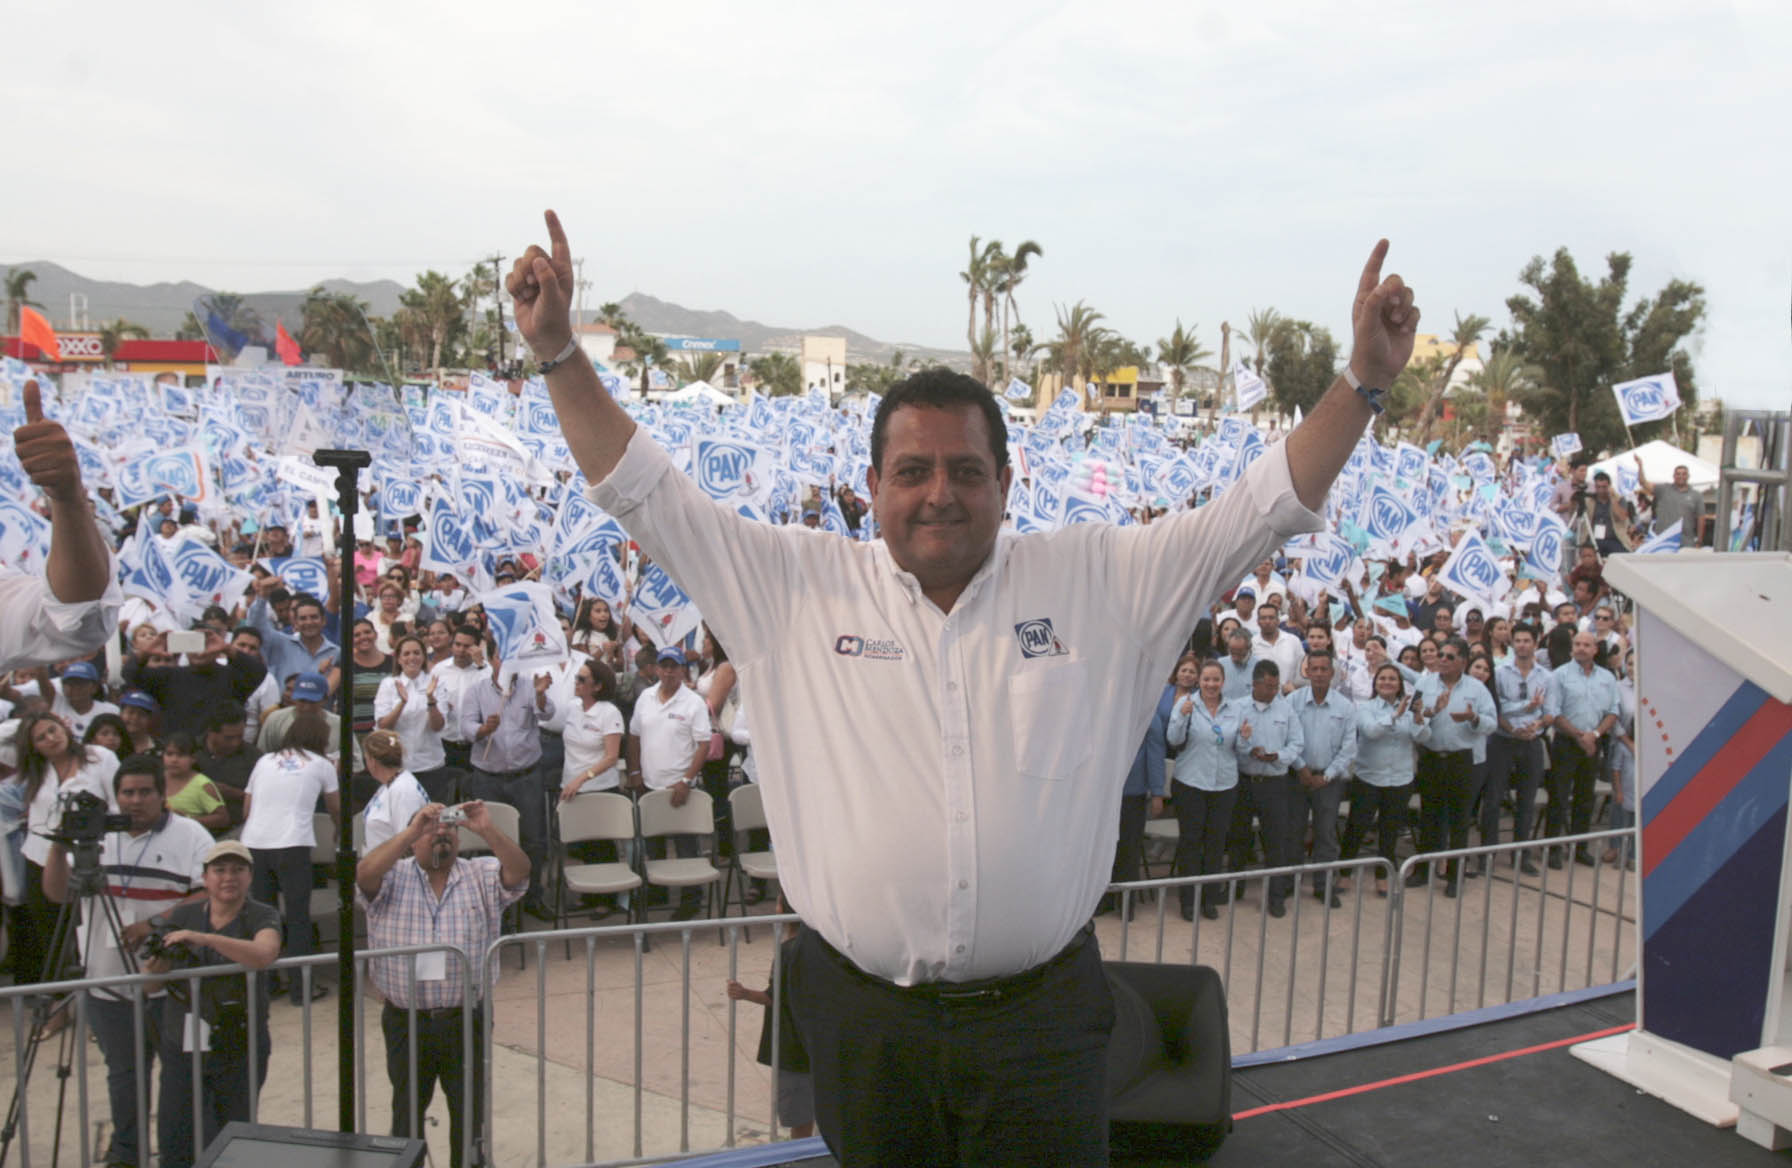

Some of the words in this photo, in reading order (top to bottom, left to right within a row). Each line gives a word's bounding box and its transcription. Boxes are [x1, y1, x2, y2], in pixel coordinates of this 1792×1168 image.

[392, 487, 416, 506] PAN
[180, 559, 222, 593] PAN
[1025, 627, 1049, 649] PAN
